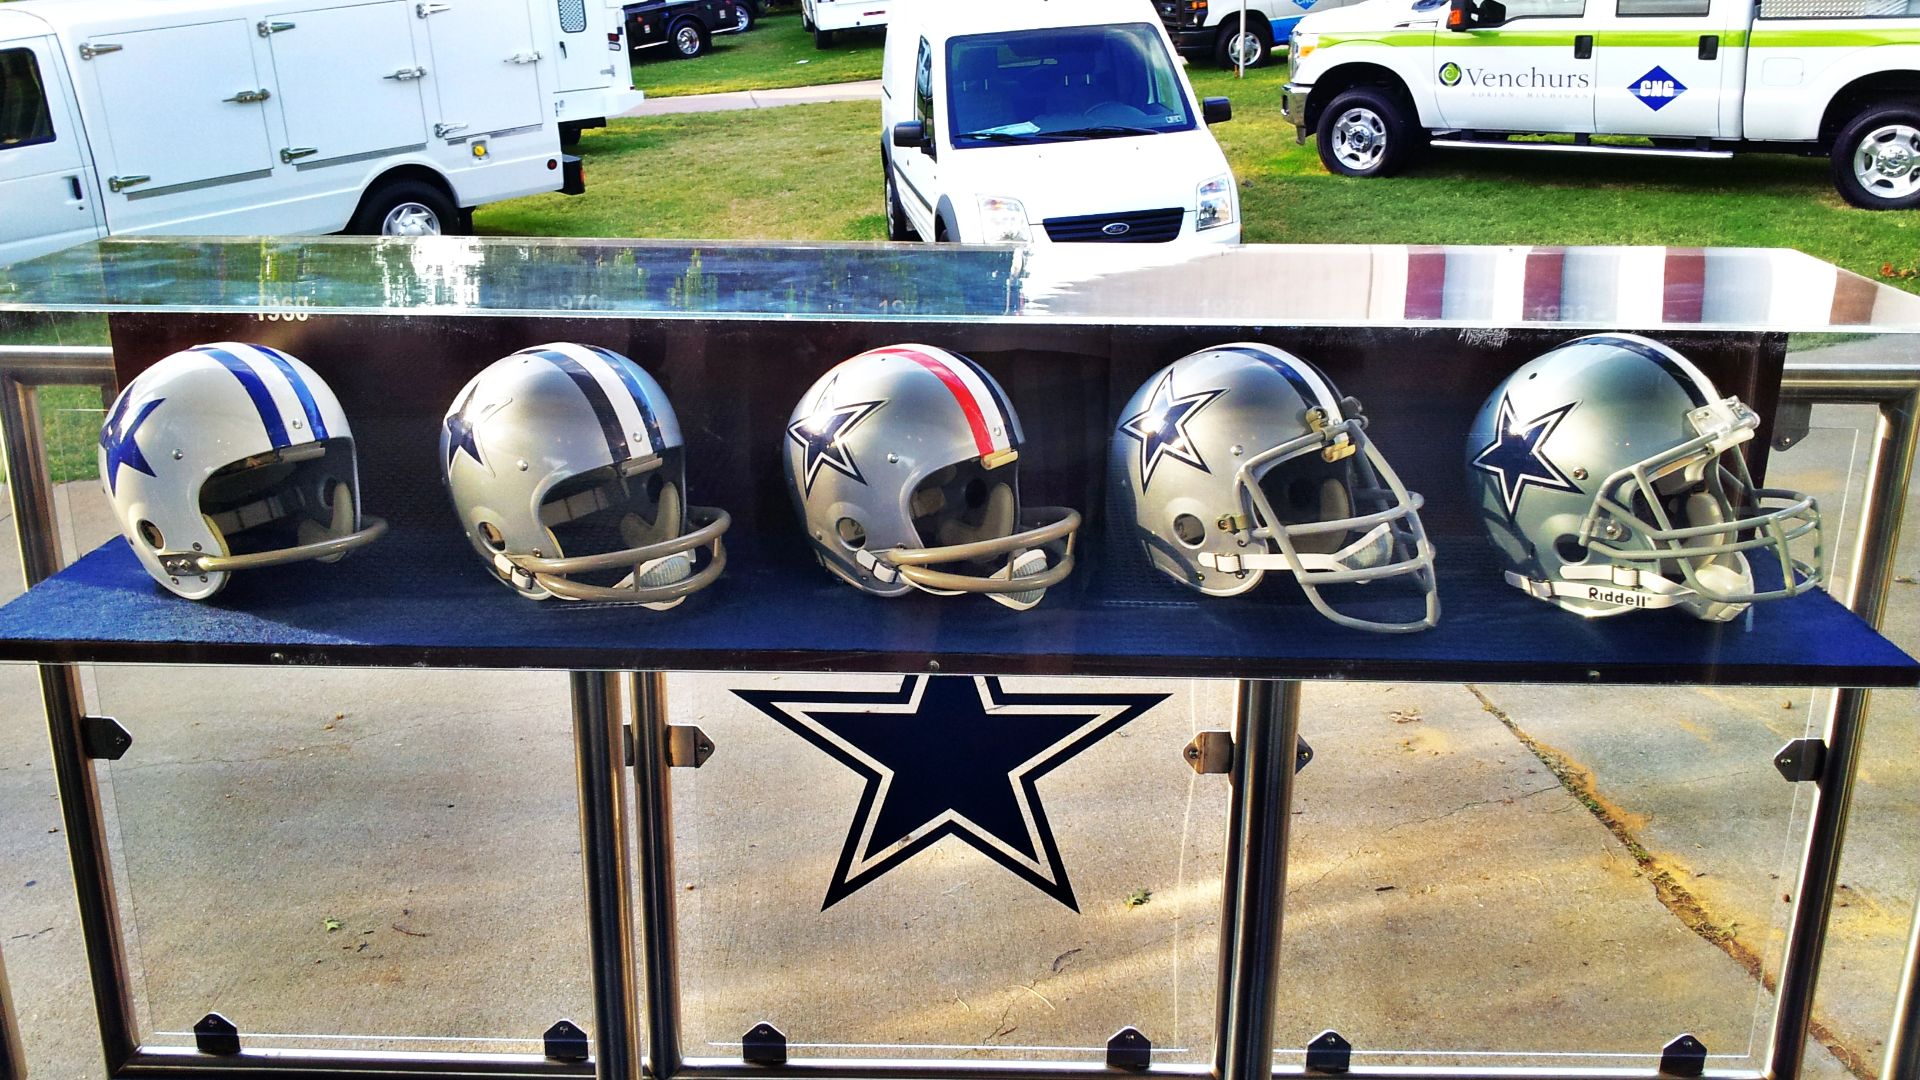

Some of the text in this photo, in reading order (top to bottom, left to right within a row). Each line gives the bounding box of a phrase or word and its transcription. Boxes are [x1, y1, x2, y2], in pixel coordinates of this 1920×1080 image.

[1466, 67, 1590, 88] Venchurs
[1640, 80, 1675, 97] CNG
[258, 296, 308, 321] 1960
[1588, 587, 1645, 607] Riddell
